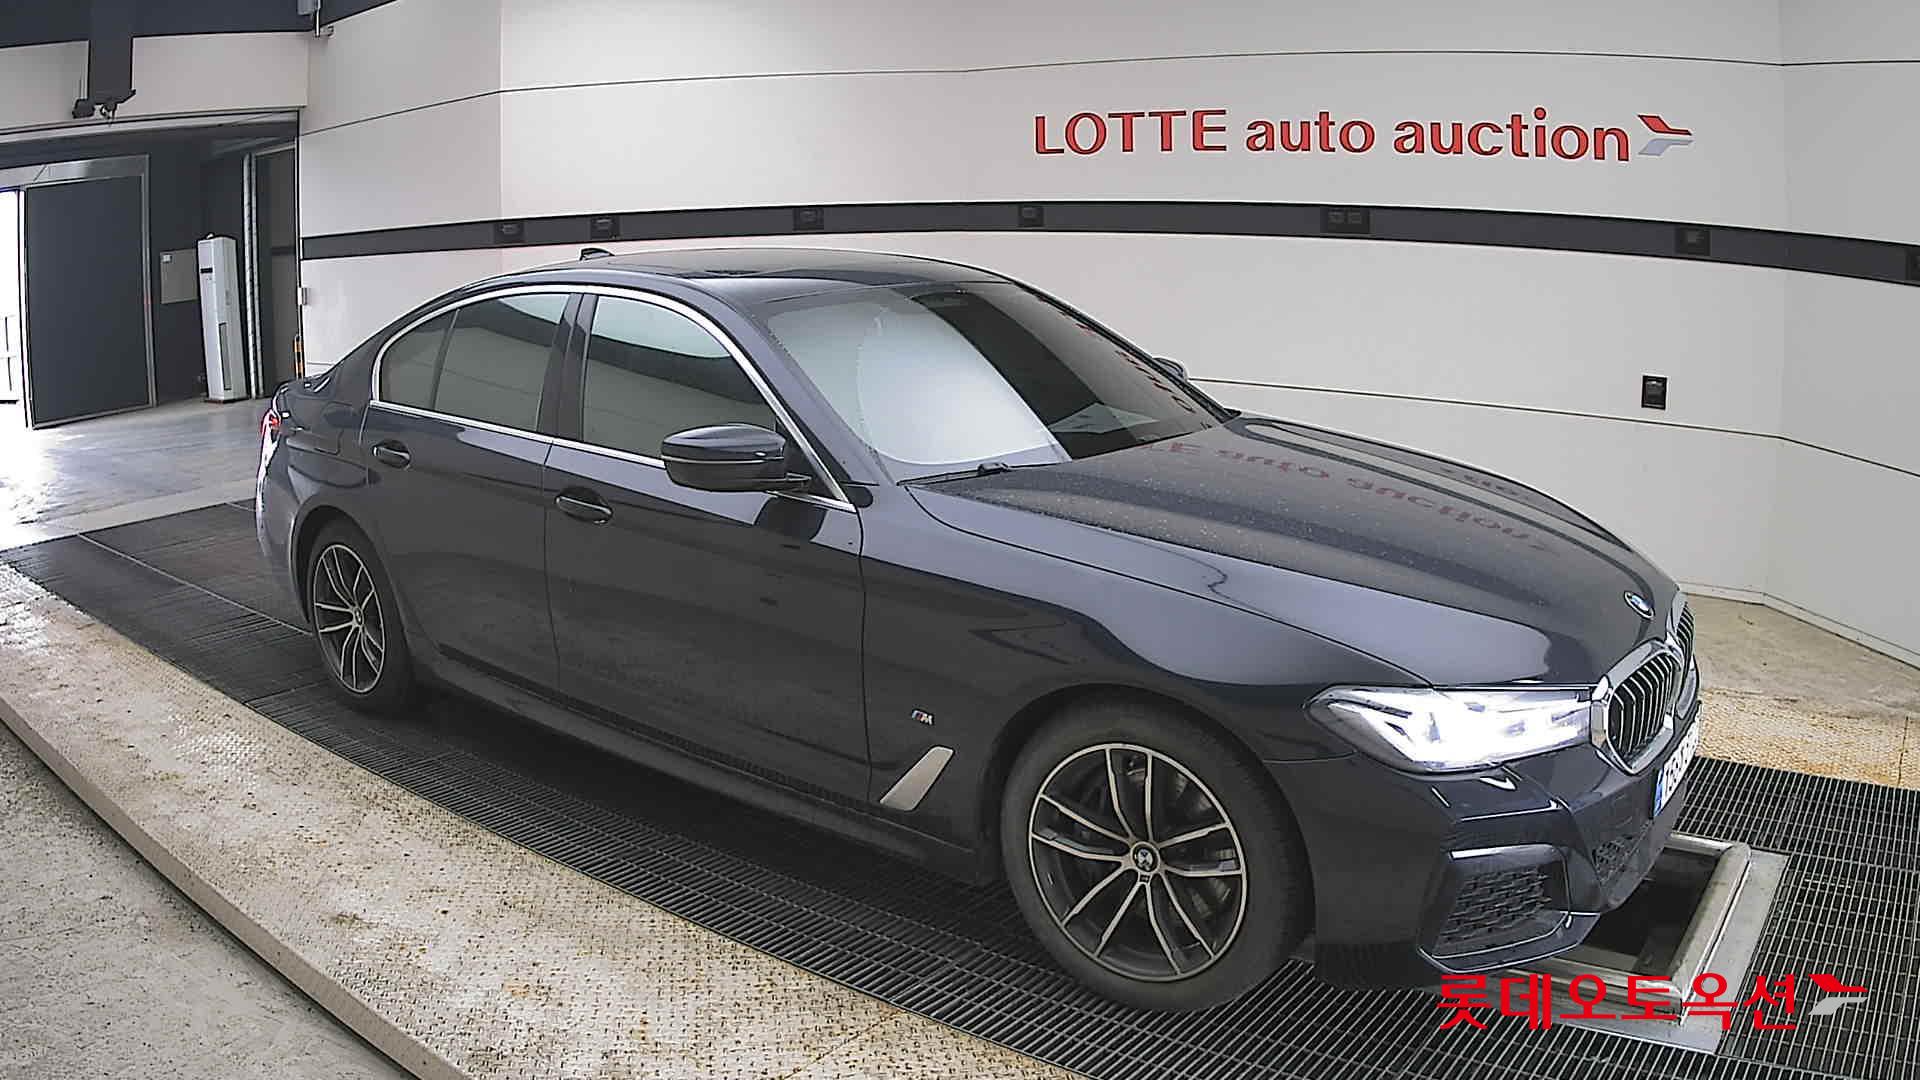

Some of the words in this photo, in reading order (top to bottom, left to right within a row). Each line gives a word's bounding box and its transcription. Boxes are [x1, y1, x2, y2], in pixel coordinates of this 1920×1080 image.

[1034, 109, 1226, 155] LOTTE
[1246, 111, 1375, 153] auto
[1393, 106, 1629, 162] auction
